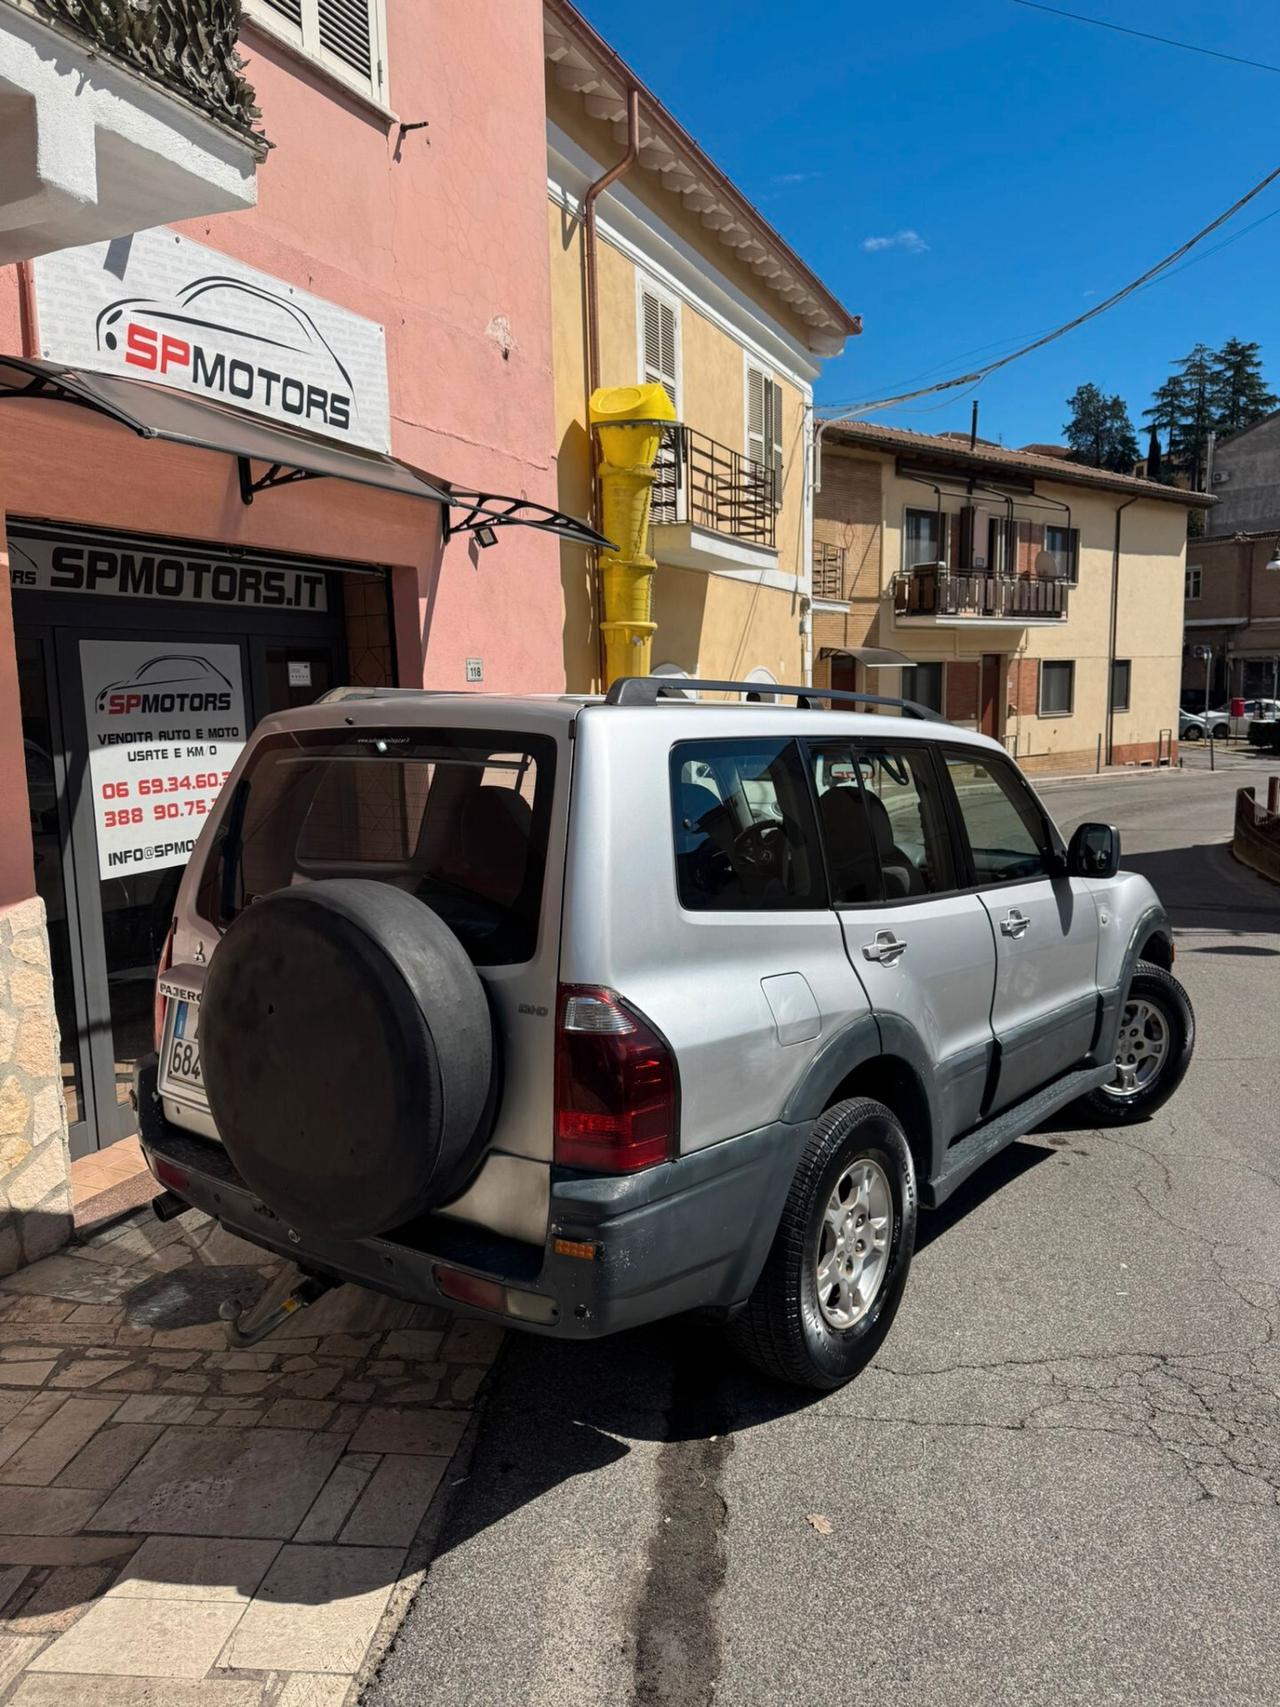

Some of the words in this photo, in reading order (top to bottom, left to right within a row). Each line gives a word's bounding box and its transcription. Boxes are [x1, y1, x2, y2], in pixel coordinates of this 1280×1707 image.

[125, 323, 350, 430] SPMOTORS
[51, 546, 324, 609] SPMOTORS.IT
[108, 692, 232, 715] SPMOTORS
[97, 731, 153, 746] VENDITA
[159, 729, 191, 742] AUTO
[196, 728, 204, 740] E
[208, 727, 240, 739] MOTO
[127, 748, 169, 762] USATE
[174, 747, 182, 758] E
[187, 746, 205, 758] KM
[102, 781, 129, 800] 06
[104, 807, 144, 828] 388
[153, 797, 217, 821] 90.75.
[108, 838, 199, 867] INFO@SPMO
